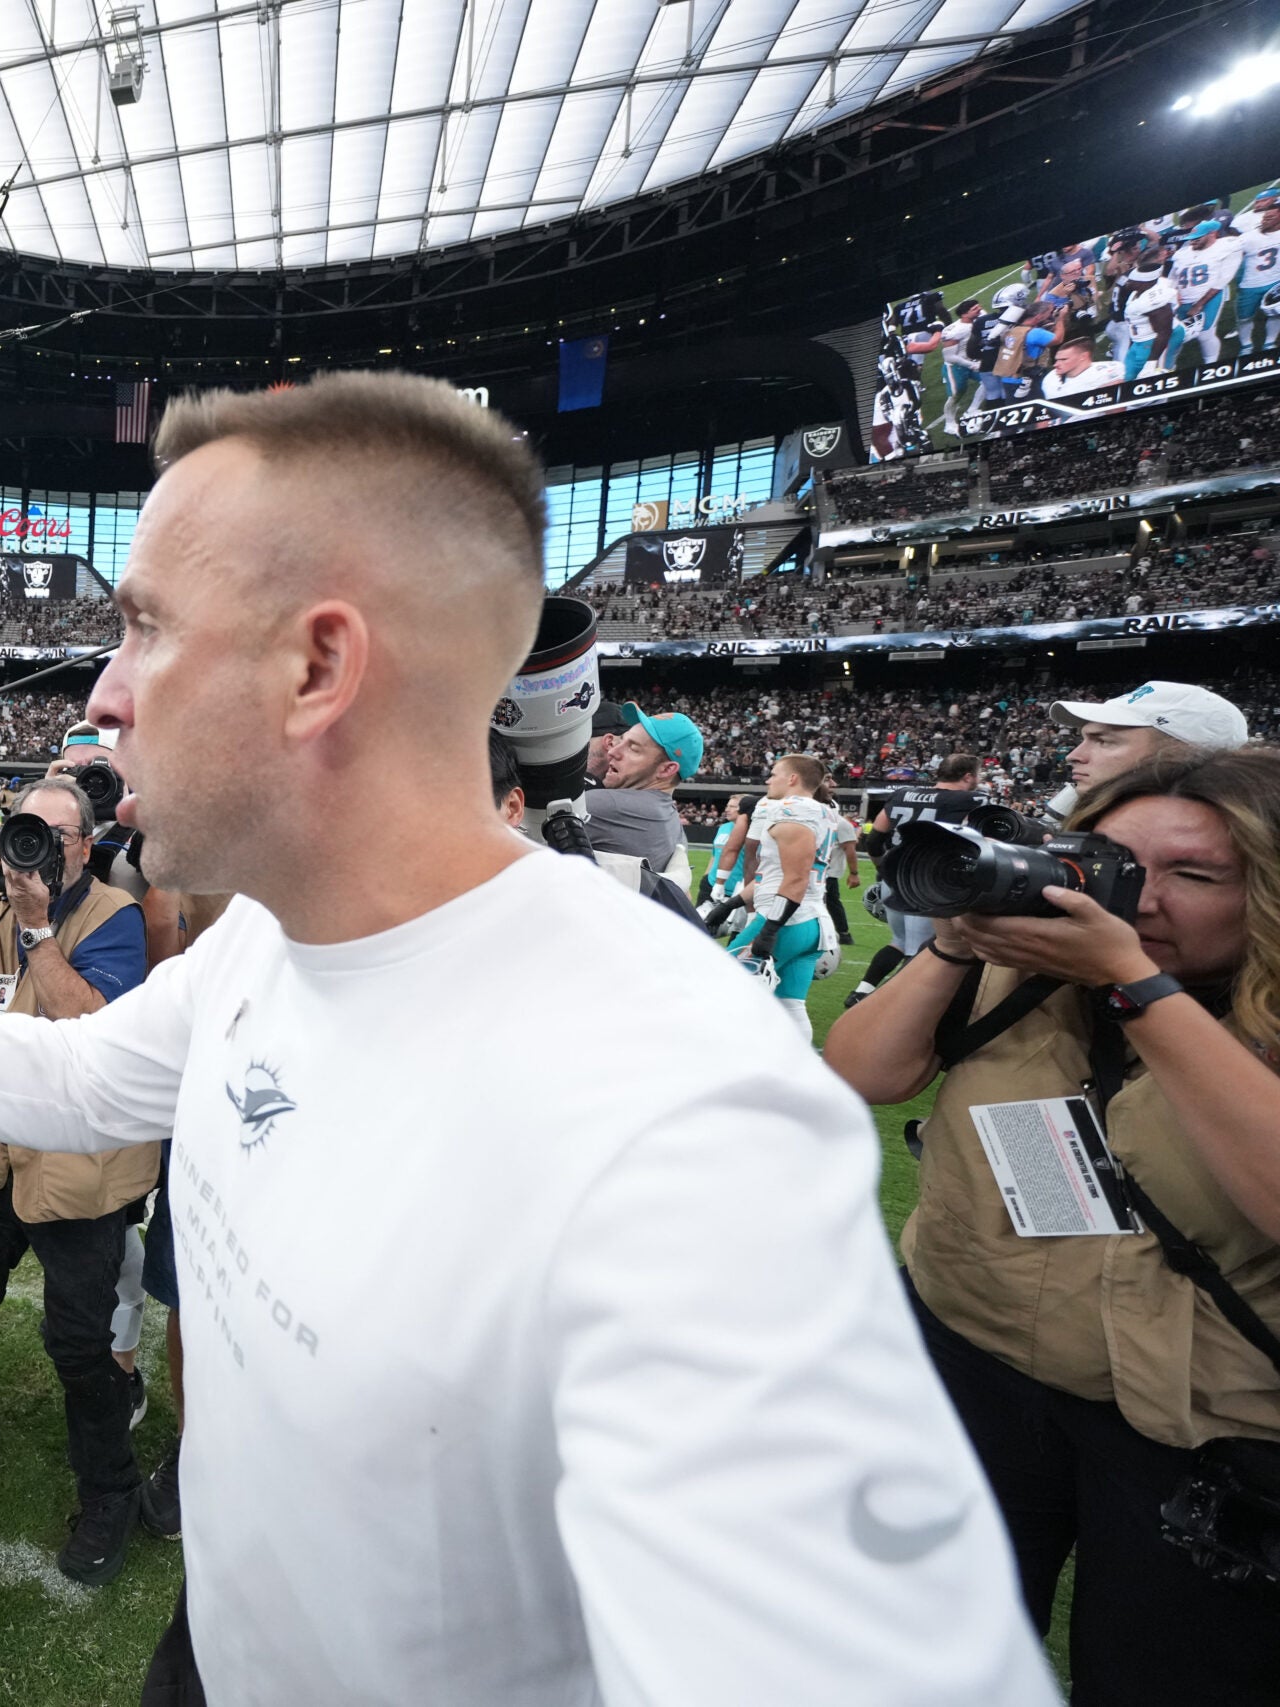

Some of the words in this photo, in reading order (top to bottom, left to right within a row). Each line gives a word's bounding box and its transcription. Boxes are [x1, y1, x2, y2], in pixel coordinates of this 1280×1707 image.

[899, 304, 927, 327] 71
[1243, 355, 1274, 371] 4th
[1201, 365, 1232, 381] 20
[1133, 377, 1179, 396] 0:15
[1082, 396, 1095, 407] 4
[1006, 407, 1034, 426] 27
[672, 492, 746, 516] MGM
[2, 538, 63, 554] LIGHT
[1045, 841, 1076, 851] SONY
[255, 1277, 320, 1359] FOR
